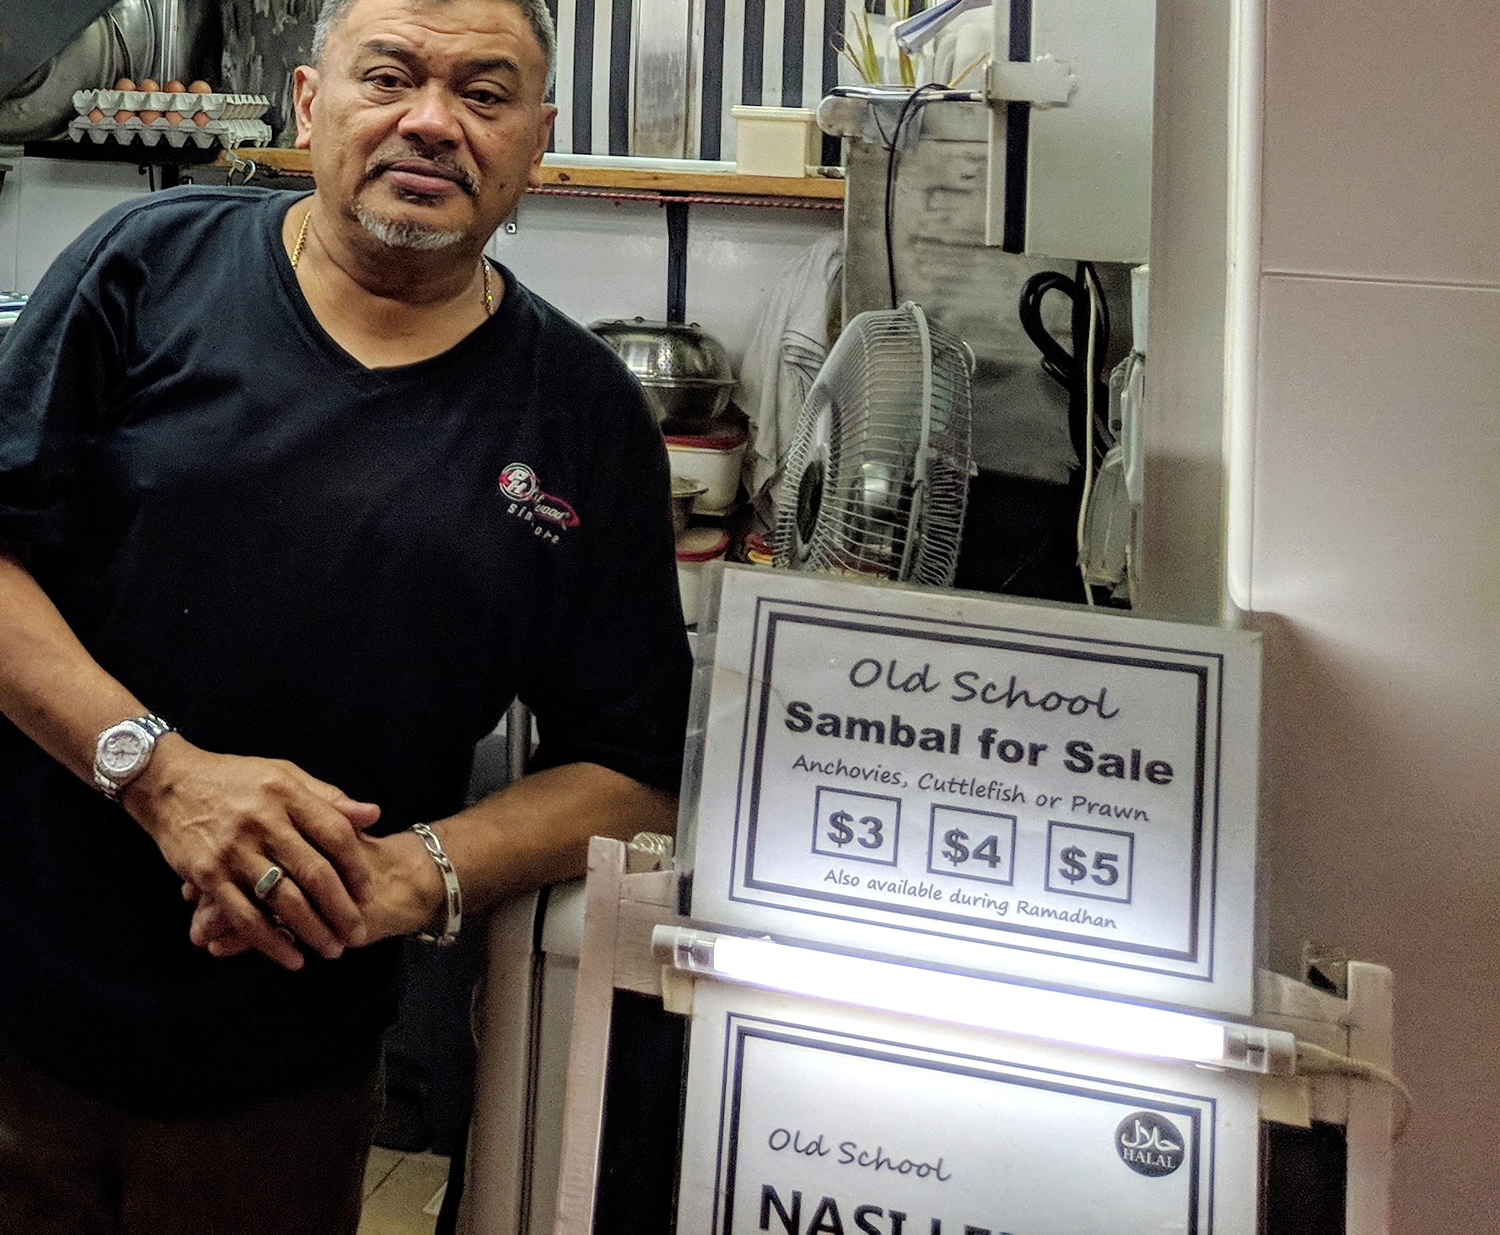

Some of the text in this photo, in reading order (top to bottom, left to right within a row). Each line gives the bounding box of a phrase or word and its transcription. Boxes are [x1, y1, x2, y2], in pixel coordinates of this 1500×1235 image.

[849, 658, 1121, 720] Old School
[783, 700, 1174, 787] Sambal for Sale
[791, 754, 1150, 824] Anchovies, Cuttlefish or Prawn
[826, 809, 885, 852] $3
[940, 827, 1001, 869] $4
[1058, 845, 1120, 887] $5
[824, 869, 1118, 930] Also available during Ramadhan
[767, 1127, 953, 1182] Old School
[1120, 1118, 1181, 1153] حلال
[1122, 1149, 1176, 1170] HALAL
